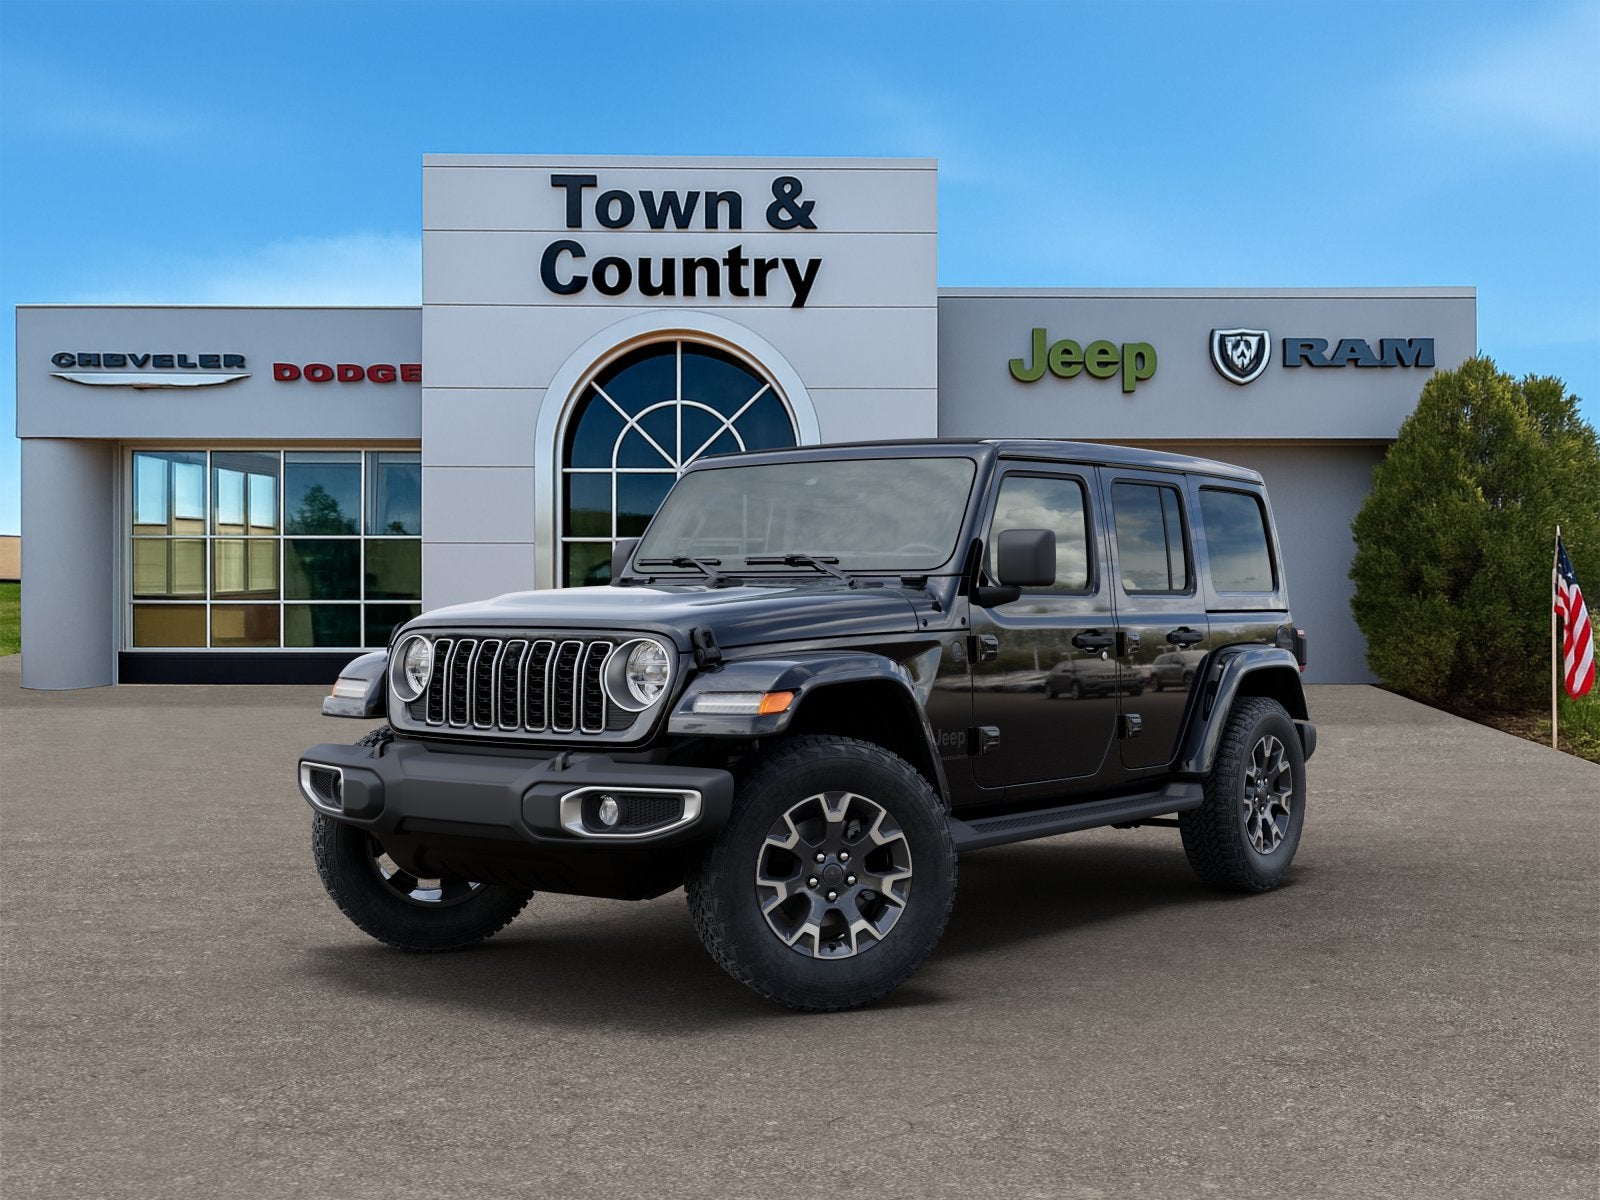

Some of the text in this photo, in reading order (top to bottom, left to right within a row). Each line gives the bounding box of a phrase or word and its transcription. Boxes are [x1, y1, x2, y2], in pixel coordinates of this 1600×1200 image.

[550, 174, 818, 230] Town &
[539, 239, 823, 308] Country
[273, 363, 422, 383] DODGE
[1008, 327, 1158, 393] Jeep
[1282, 337, 1436, 368] RAM
[936, 728, 966, 748] Jeep
